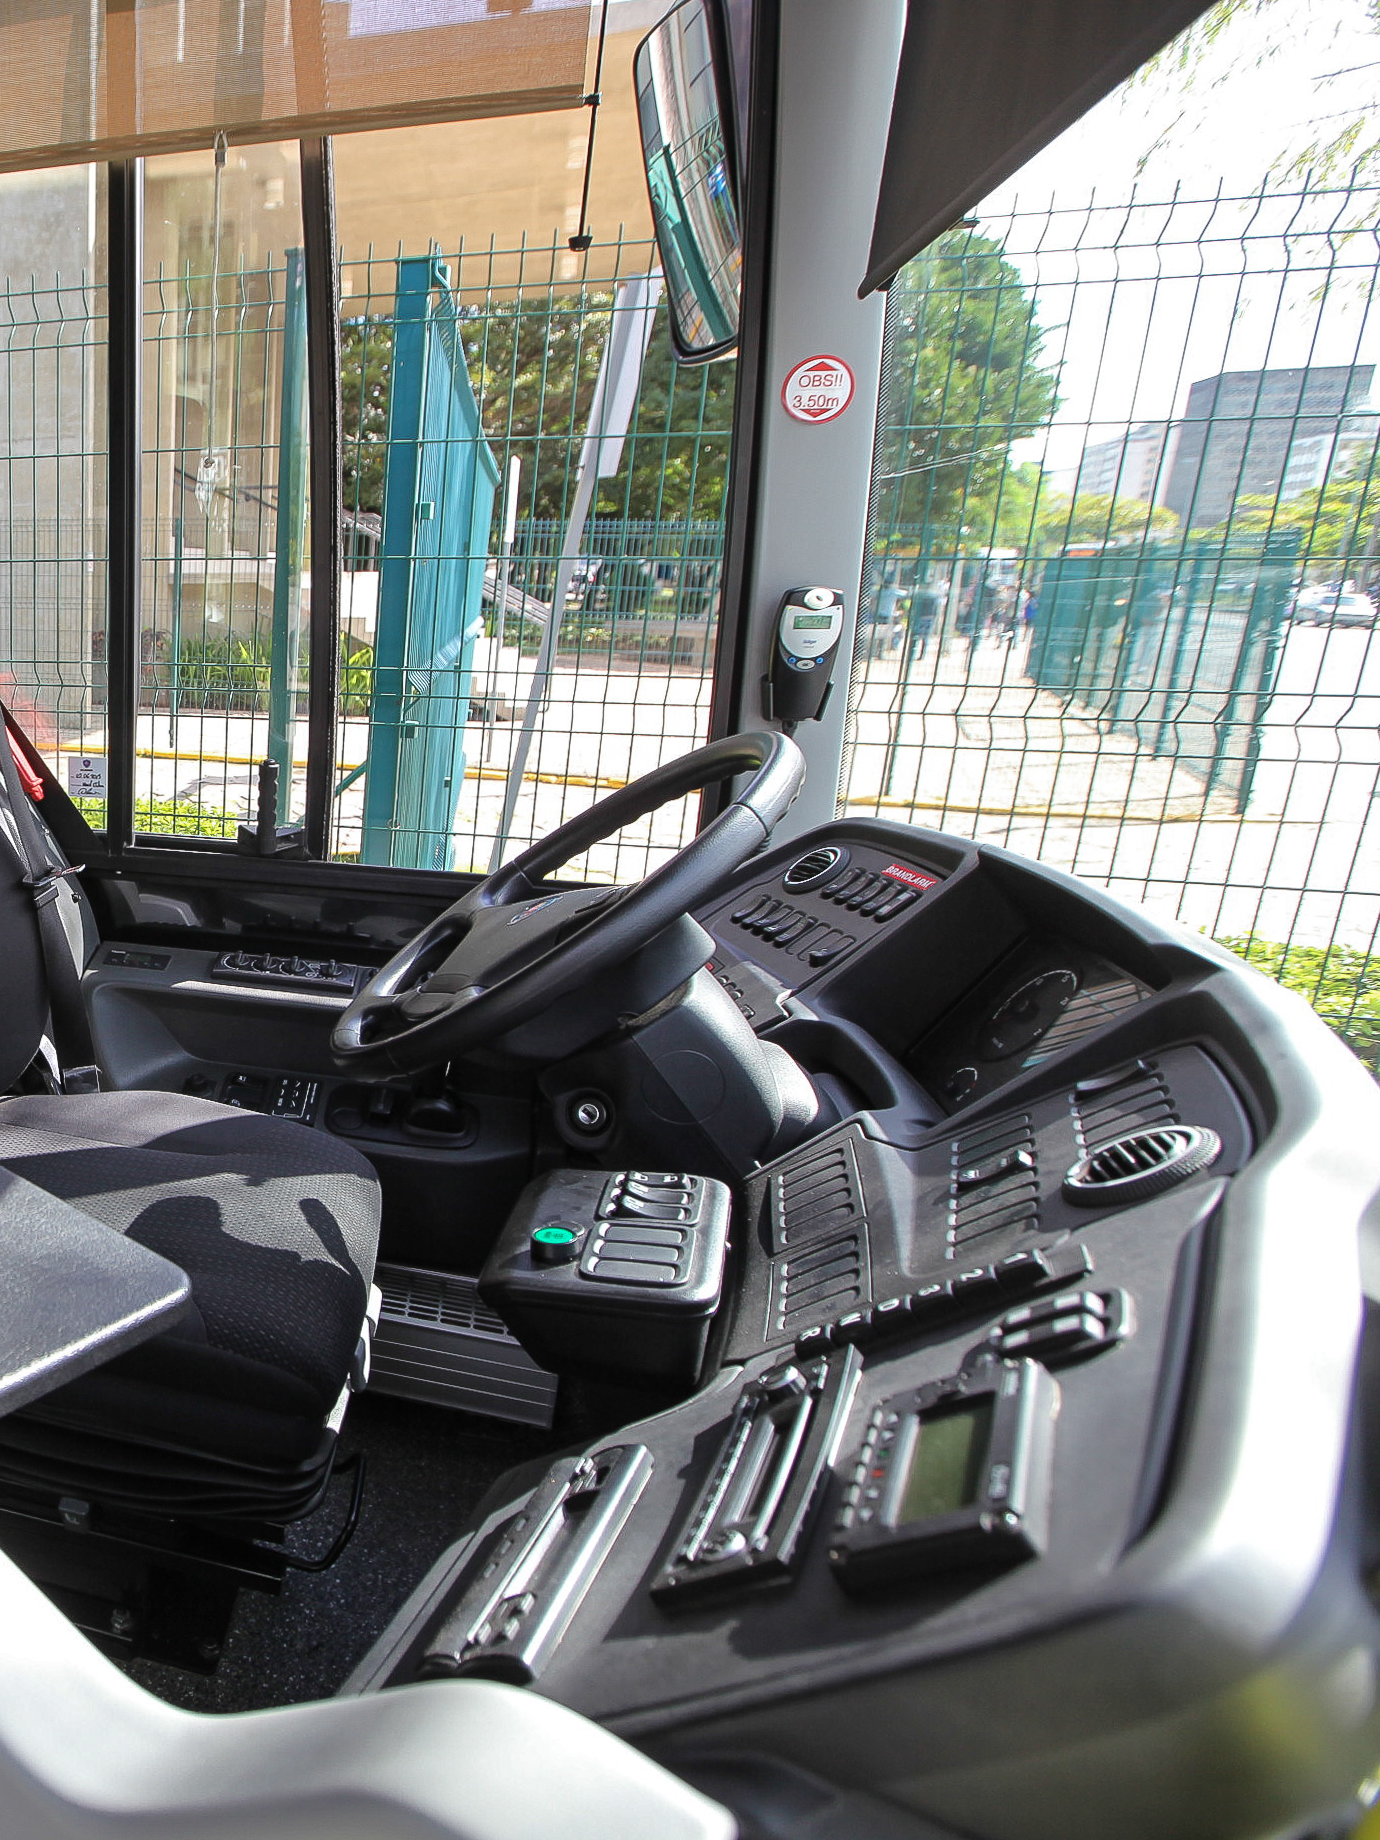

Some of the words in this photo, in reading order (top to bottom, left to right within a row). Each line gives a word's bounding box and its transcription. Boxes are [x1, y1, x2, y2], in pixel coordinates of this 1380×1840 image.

[798, 373, 844, 388] OBS!!
[792, 394, 840, 409] 3.50m
[885, 865, 934, 889] BRANDLARM
[959, 1268, 984, 1282] 2
[918, 1284, 941, 1297] 3
[839, 1312, 862, 1327] N
[799, 1327, 822, 1342] R
